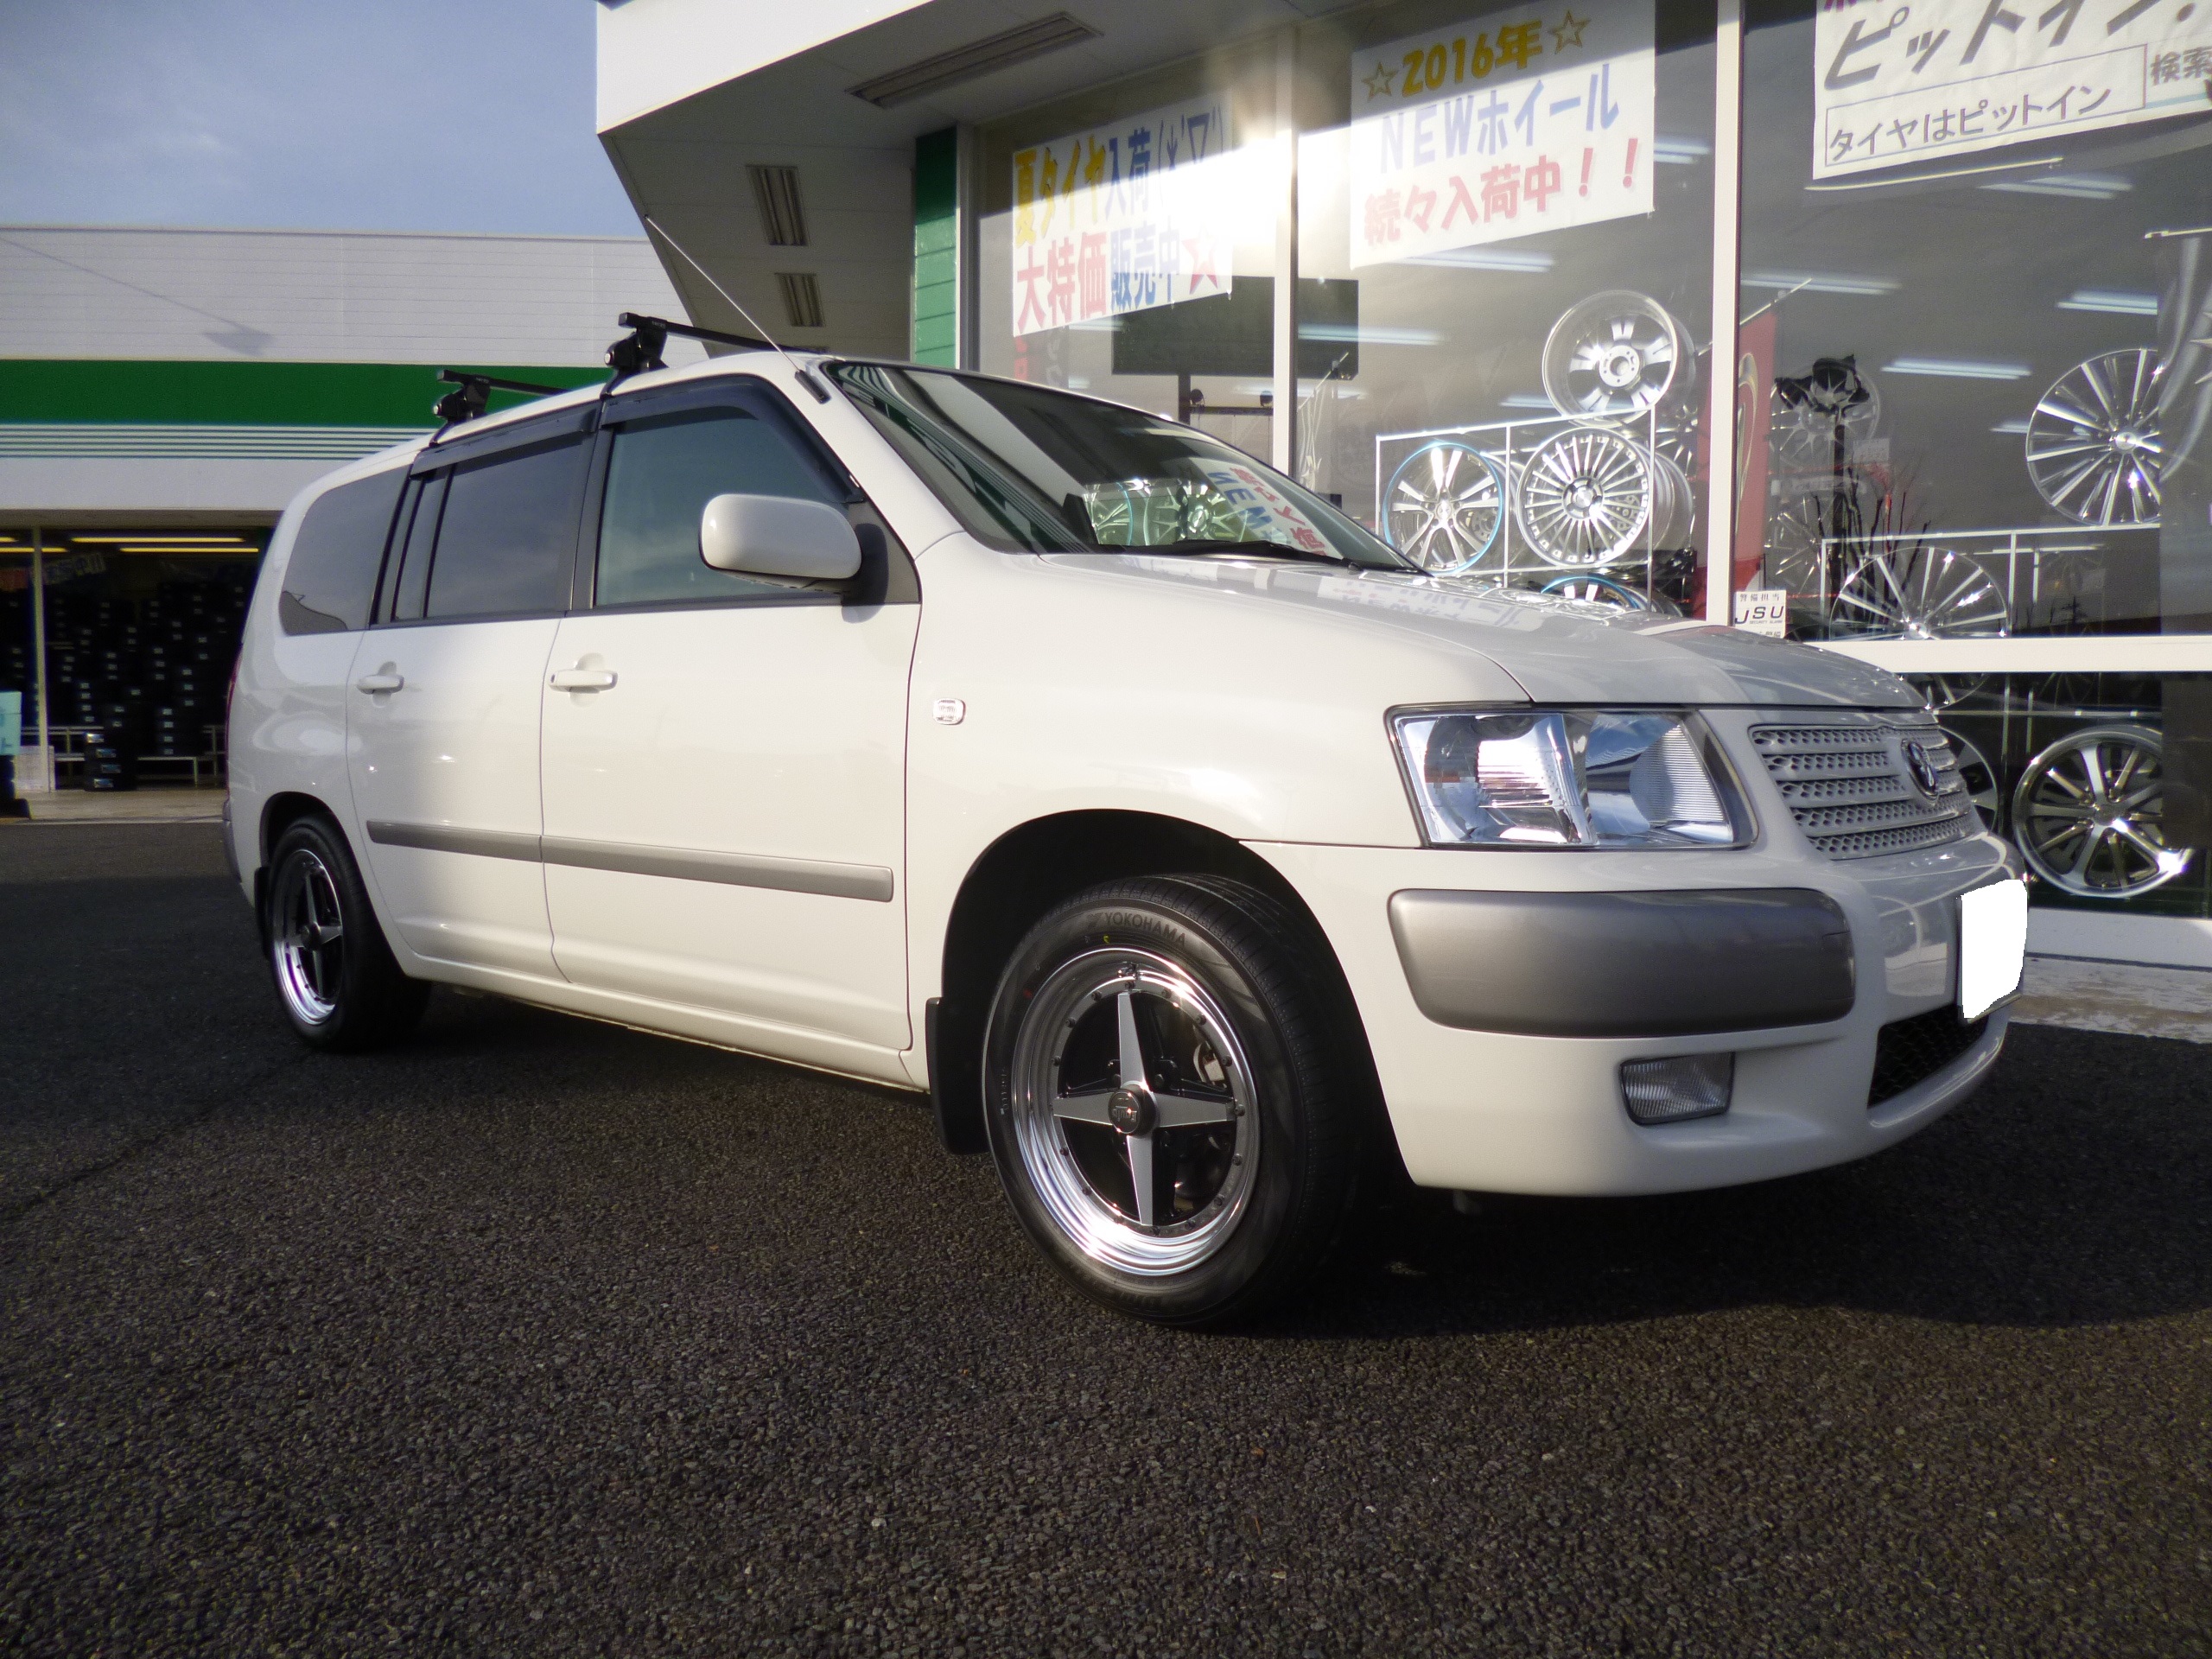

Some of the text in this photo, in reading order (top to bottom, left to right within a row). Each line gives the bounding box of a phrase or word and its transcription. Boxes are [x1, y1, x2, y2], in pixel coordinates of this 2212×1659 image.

[1383, 63, 1619, 173] NEWホイール
[1829, 86, 2111, 162] タイヤはピットイン
[1735, 606, 1783, 624] JSU
[1104, 912, 1185, 948] YOKOHAMA
